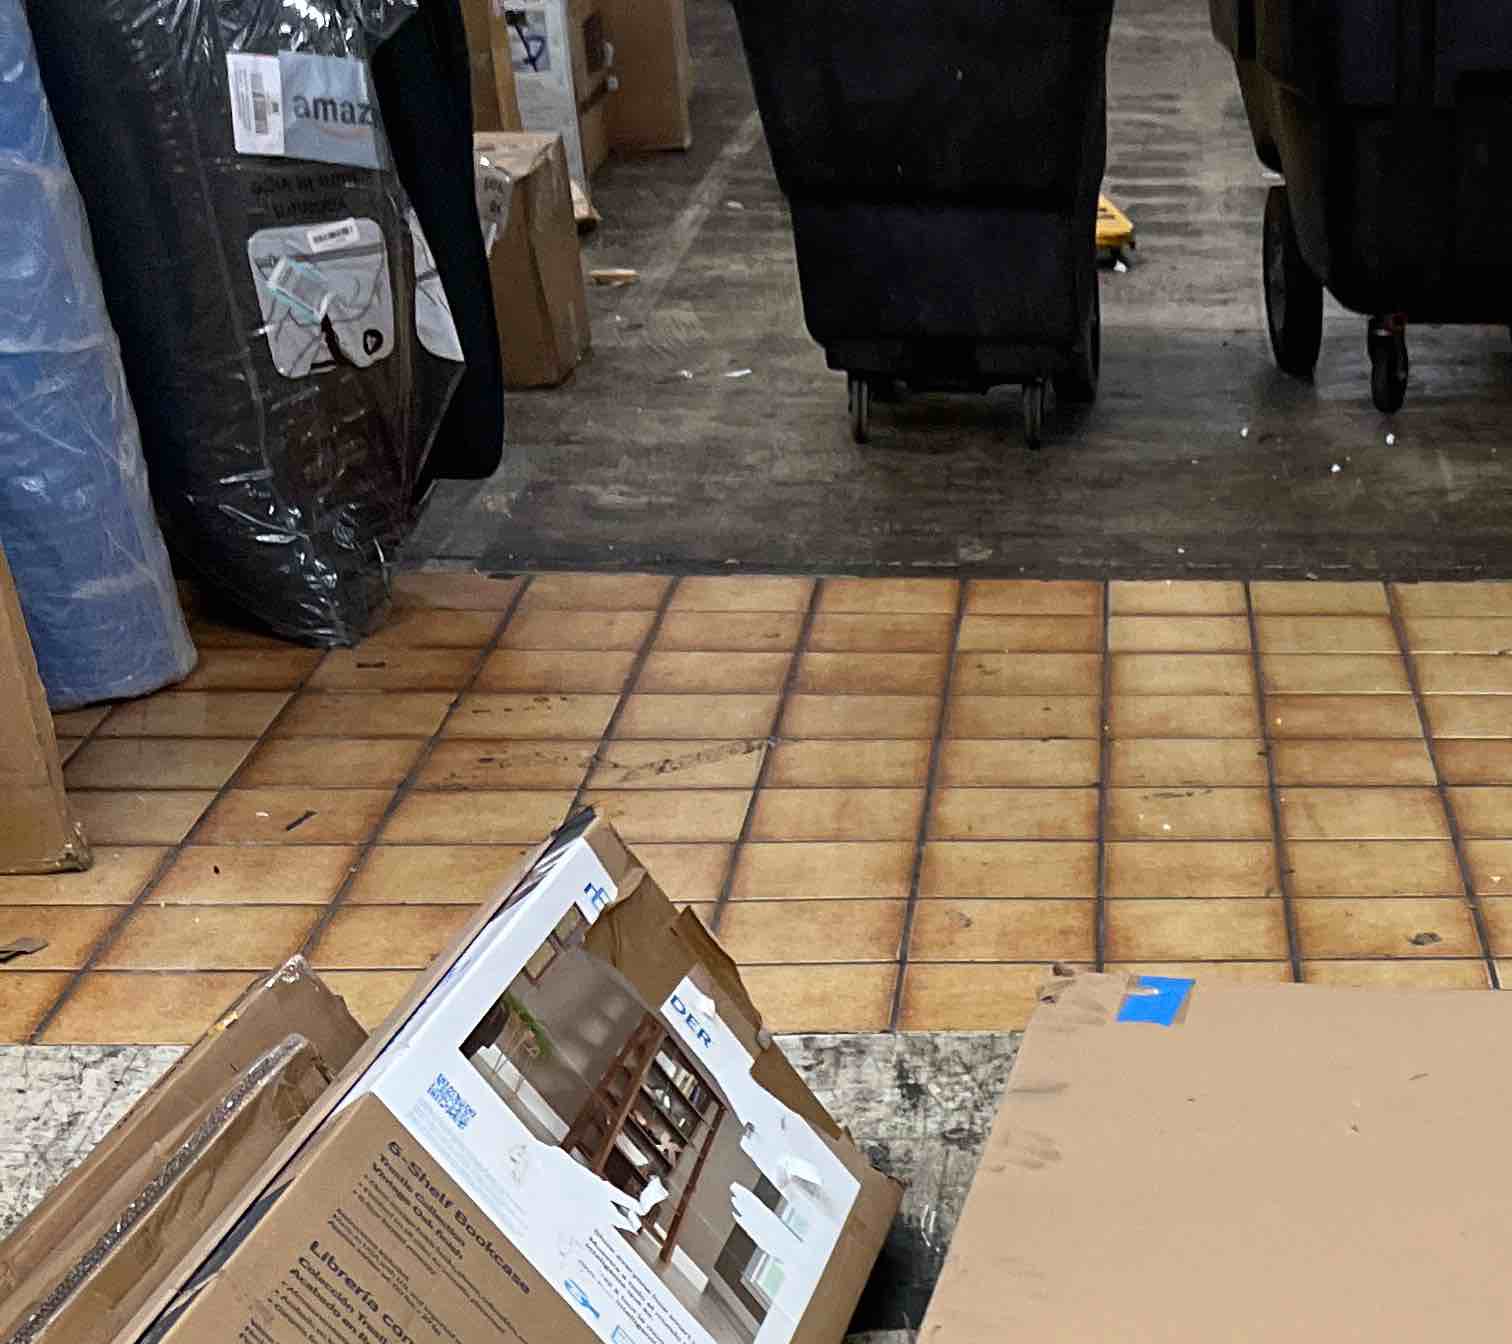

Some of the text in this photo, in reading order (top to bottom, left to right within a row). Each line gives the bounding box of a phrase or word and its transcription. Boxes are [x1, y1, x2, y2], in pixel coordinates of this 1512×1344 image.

[670, 994, 712, 1049] DER
[309, 1240, 379, 1313] Librería
[454, 1210, 530, 1294] Bookcase
